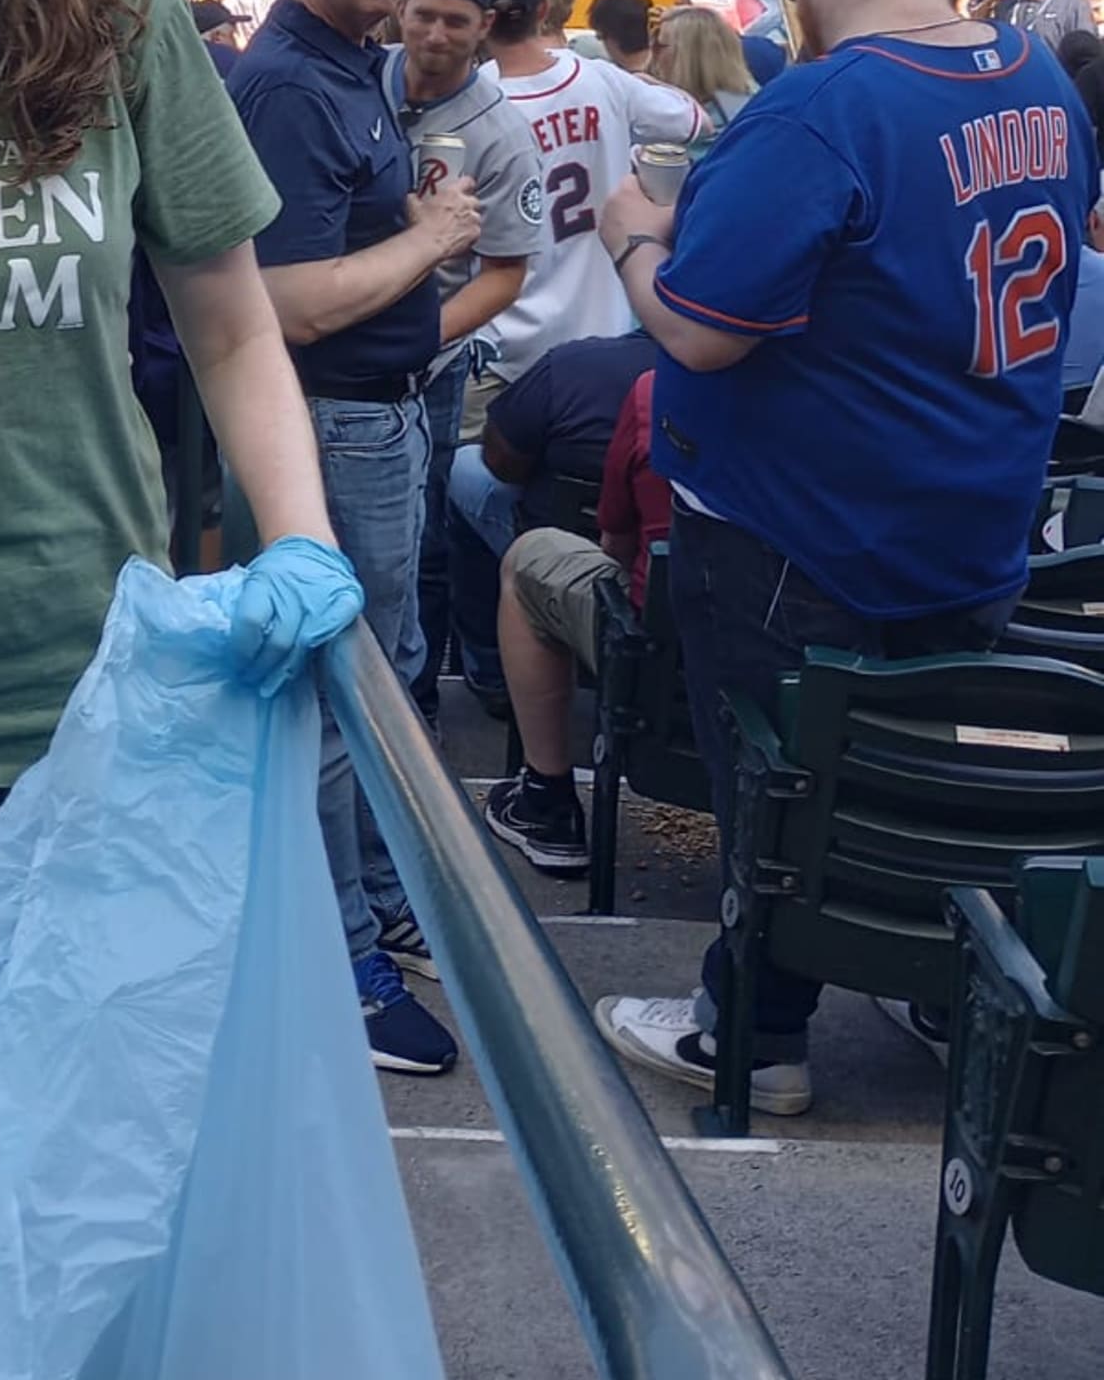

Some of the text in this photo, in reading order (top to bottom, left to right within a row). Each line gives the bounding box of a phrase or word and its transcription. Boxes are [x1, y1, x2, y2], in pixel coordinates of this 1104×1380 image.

[546, 161, 596, 244] 2
[939, 107, 1068, 206] LINDOR
[965, 204, 1067, 378] 12
